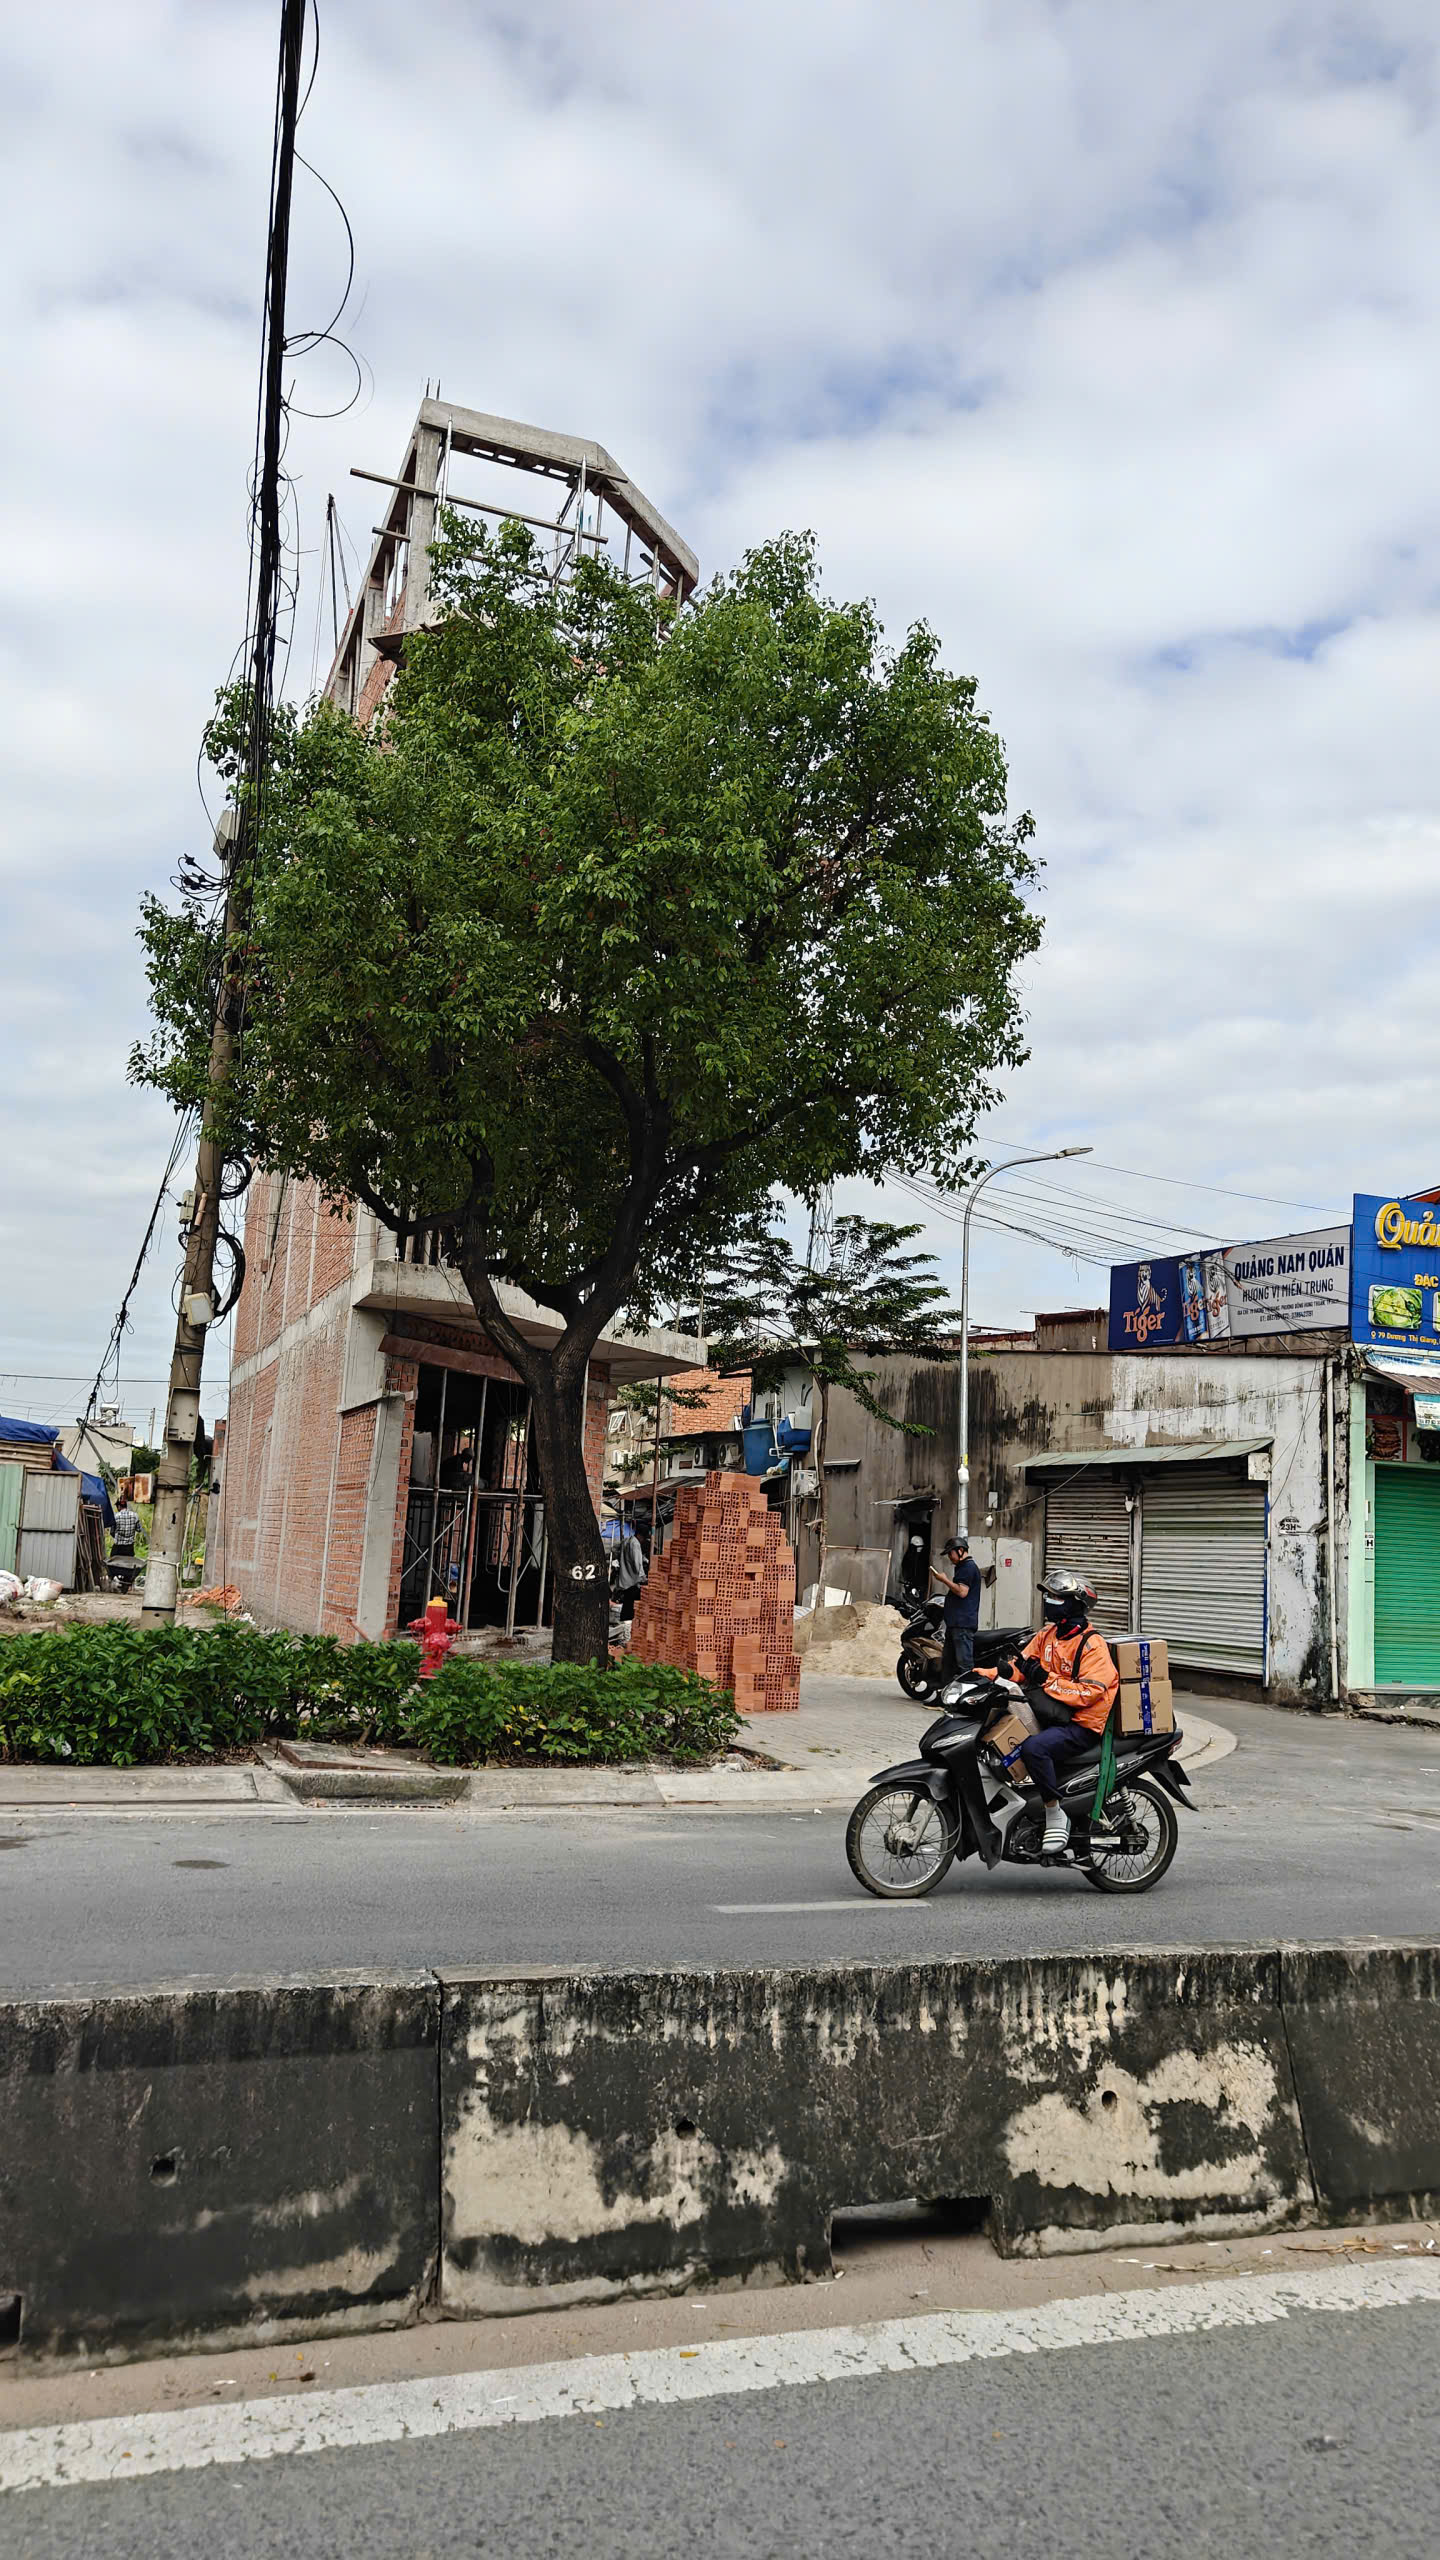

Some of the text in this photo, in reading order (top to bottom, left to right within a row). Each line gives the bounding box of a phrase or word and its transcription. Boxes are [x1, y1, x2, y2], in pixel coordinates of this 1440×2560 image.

[1375, 1202, 1440, 1250] Quả
[1234, 1243, 1344, 1281] QUẢNG NAM QUÁN
[1305, 1278, 1333, 1295] TRUNG
[1414, 1272, 1439, 1290] ĐẶC
[1123, 1306, 1165, 1342] Tiger
[571, 1564, 596, 1580] 62
